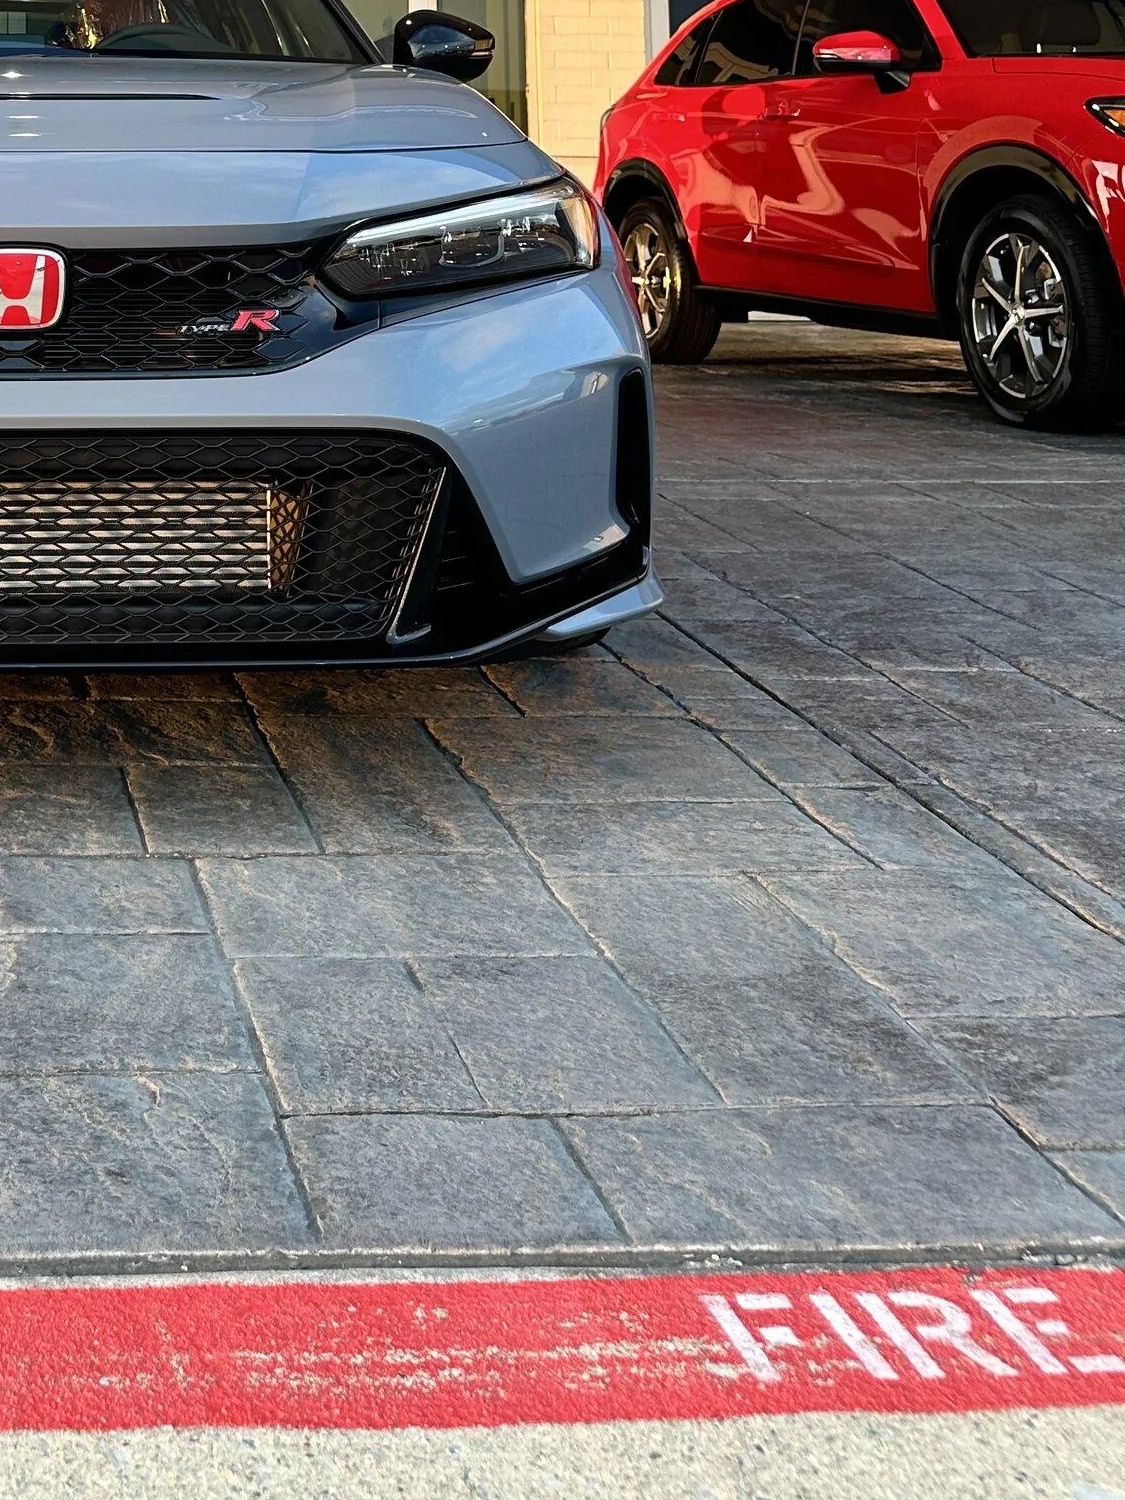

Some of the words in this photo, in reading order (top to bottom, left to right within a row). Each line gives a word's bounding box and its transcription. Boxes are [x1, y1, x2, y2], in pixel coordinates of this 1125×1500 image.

[178, 323, 231, 335] TYPE
[230, 308, 280, 332] R
[698, 1287, 1125, 1383] FIRE
